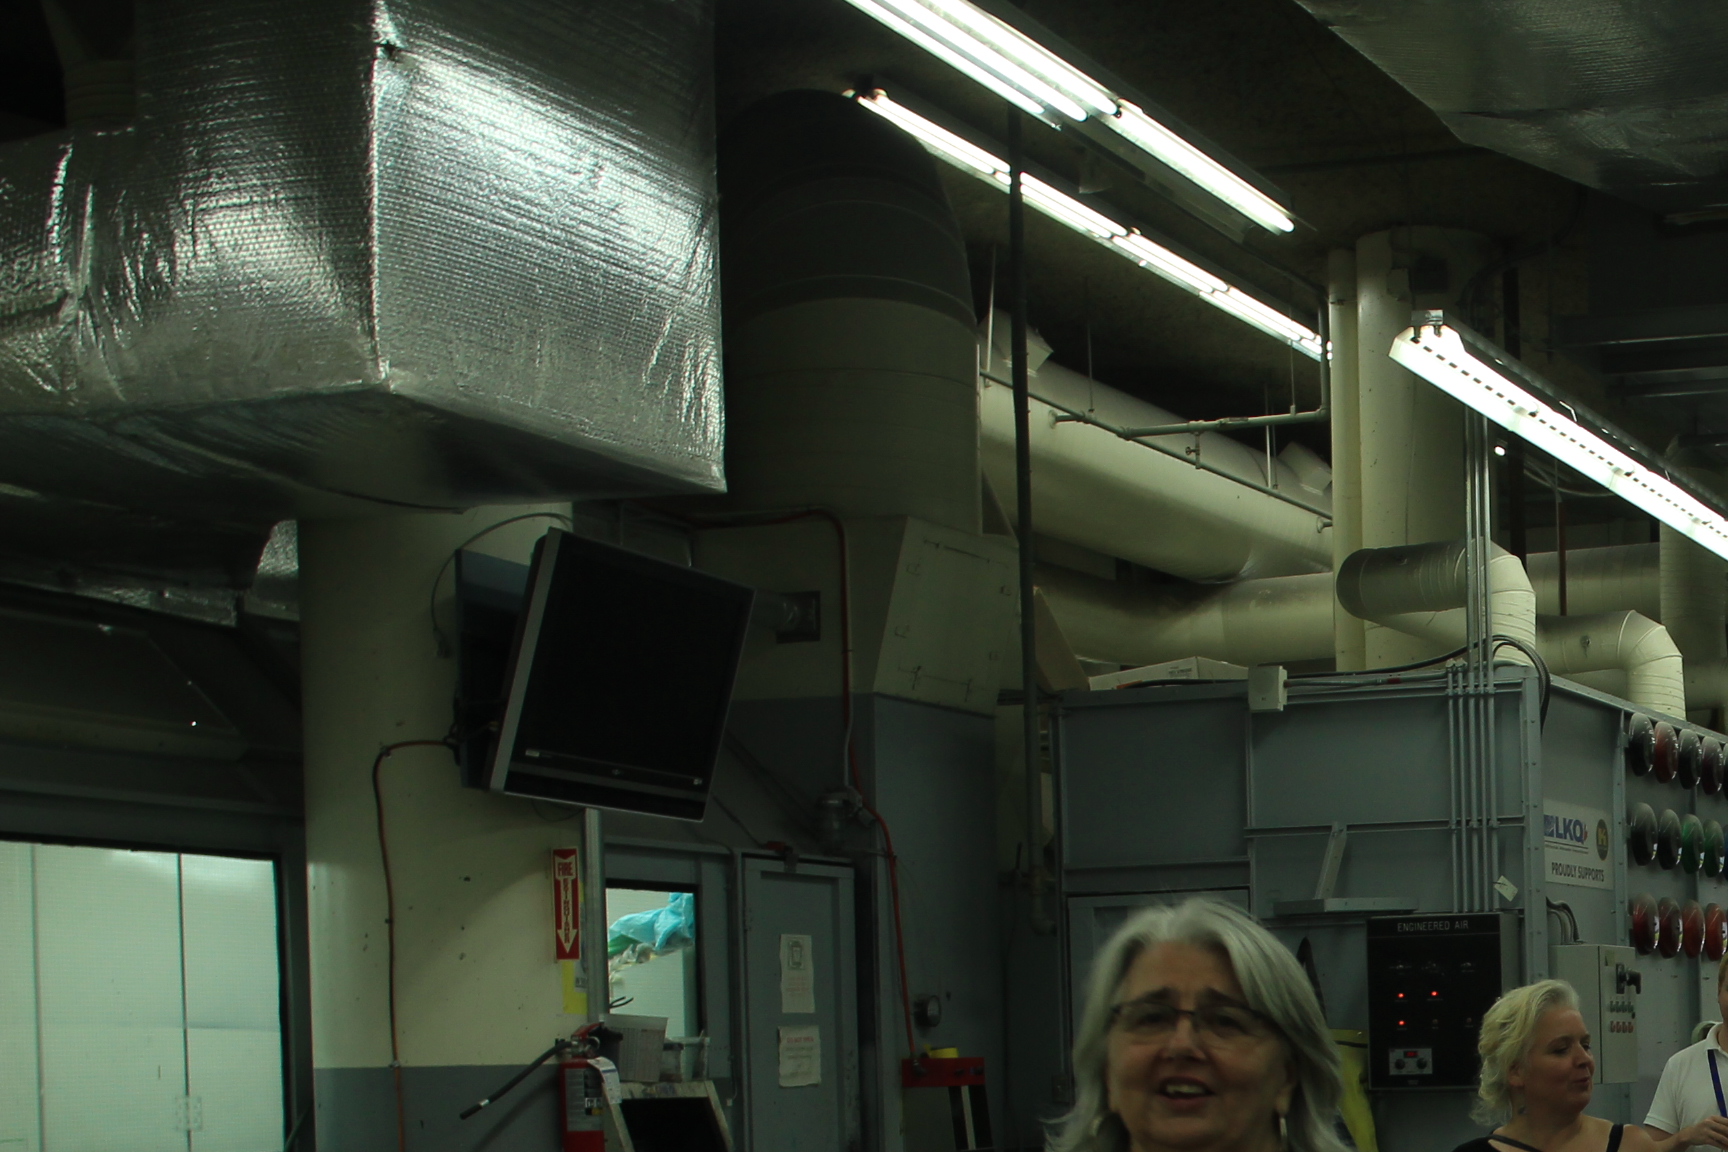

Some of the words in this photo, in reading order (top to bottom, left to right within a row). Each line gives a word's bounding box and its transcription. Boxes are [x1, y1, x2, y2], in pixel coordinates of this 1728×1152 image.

[1555, 816, 1584, 845] LKQ
[557, 861, 574, 877] FIRE
[1551, 862, 1577, 878] PROUDLY
[1578, 866, 1605, 882] SUPPORTS
[1397, 920, 1451, 933] ENGINEERED
[1454, 919, 1470, 930] AIR
